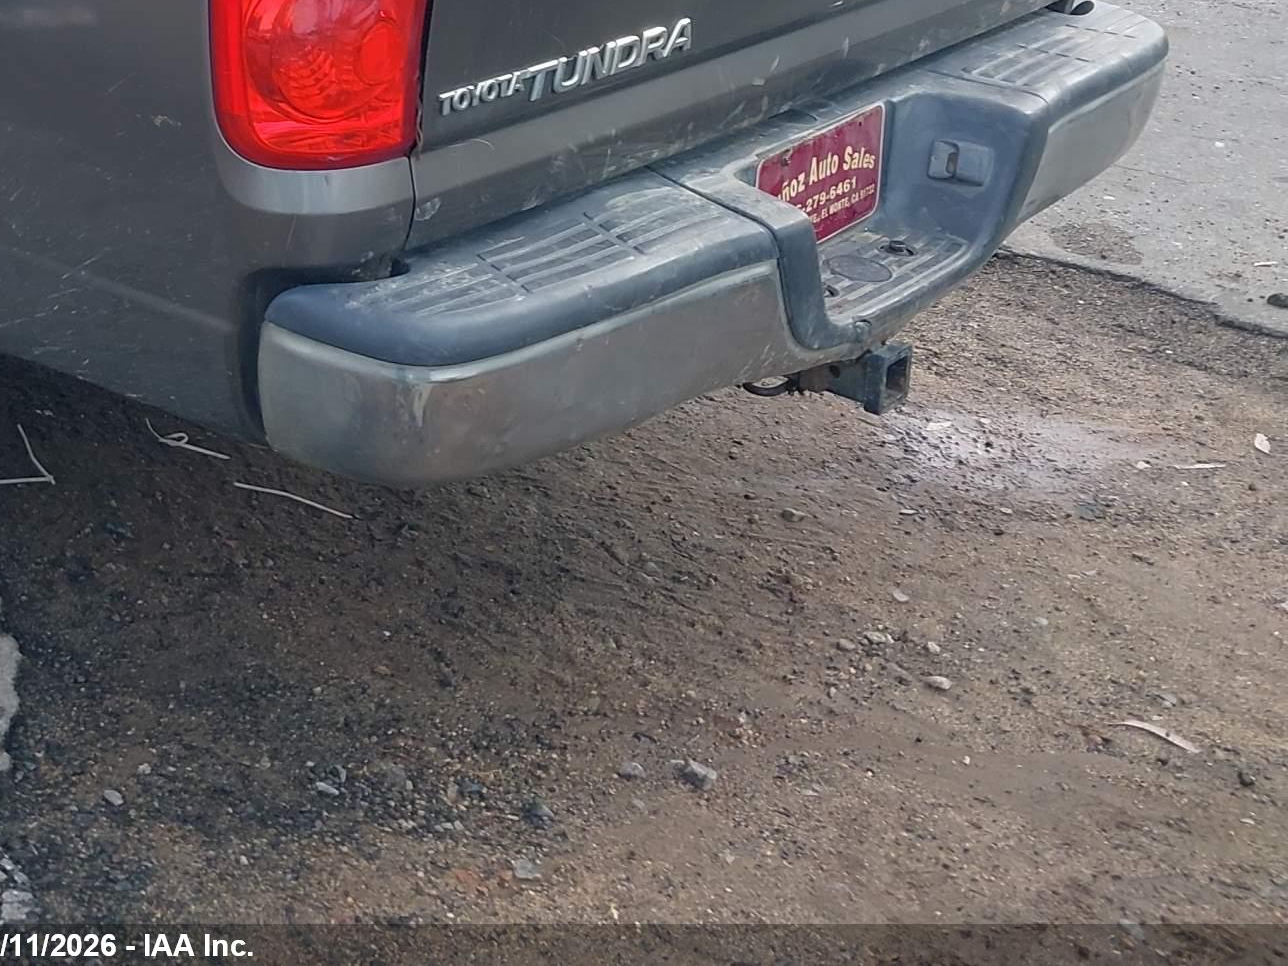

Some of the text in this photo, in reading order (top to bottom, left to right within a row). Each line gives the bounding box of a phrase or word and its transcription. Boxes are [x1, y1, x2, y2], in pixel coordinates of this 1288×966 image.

[439, 17, 692, 116] TOYOTA TUNDRA
[778, 145, 876, 202] ñoz Auto Sales
[797, 176, 857, 213] -279-6461
